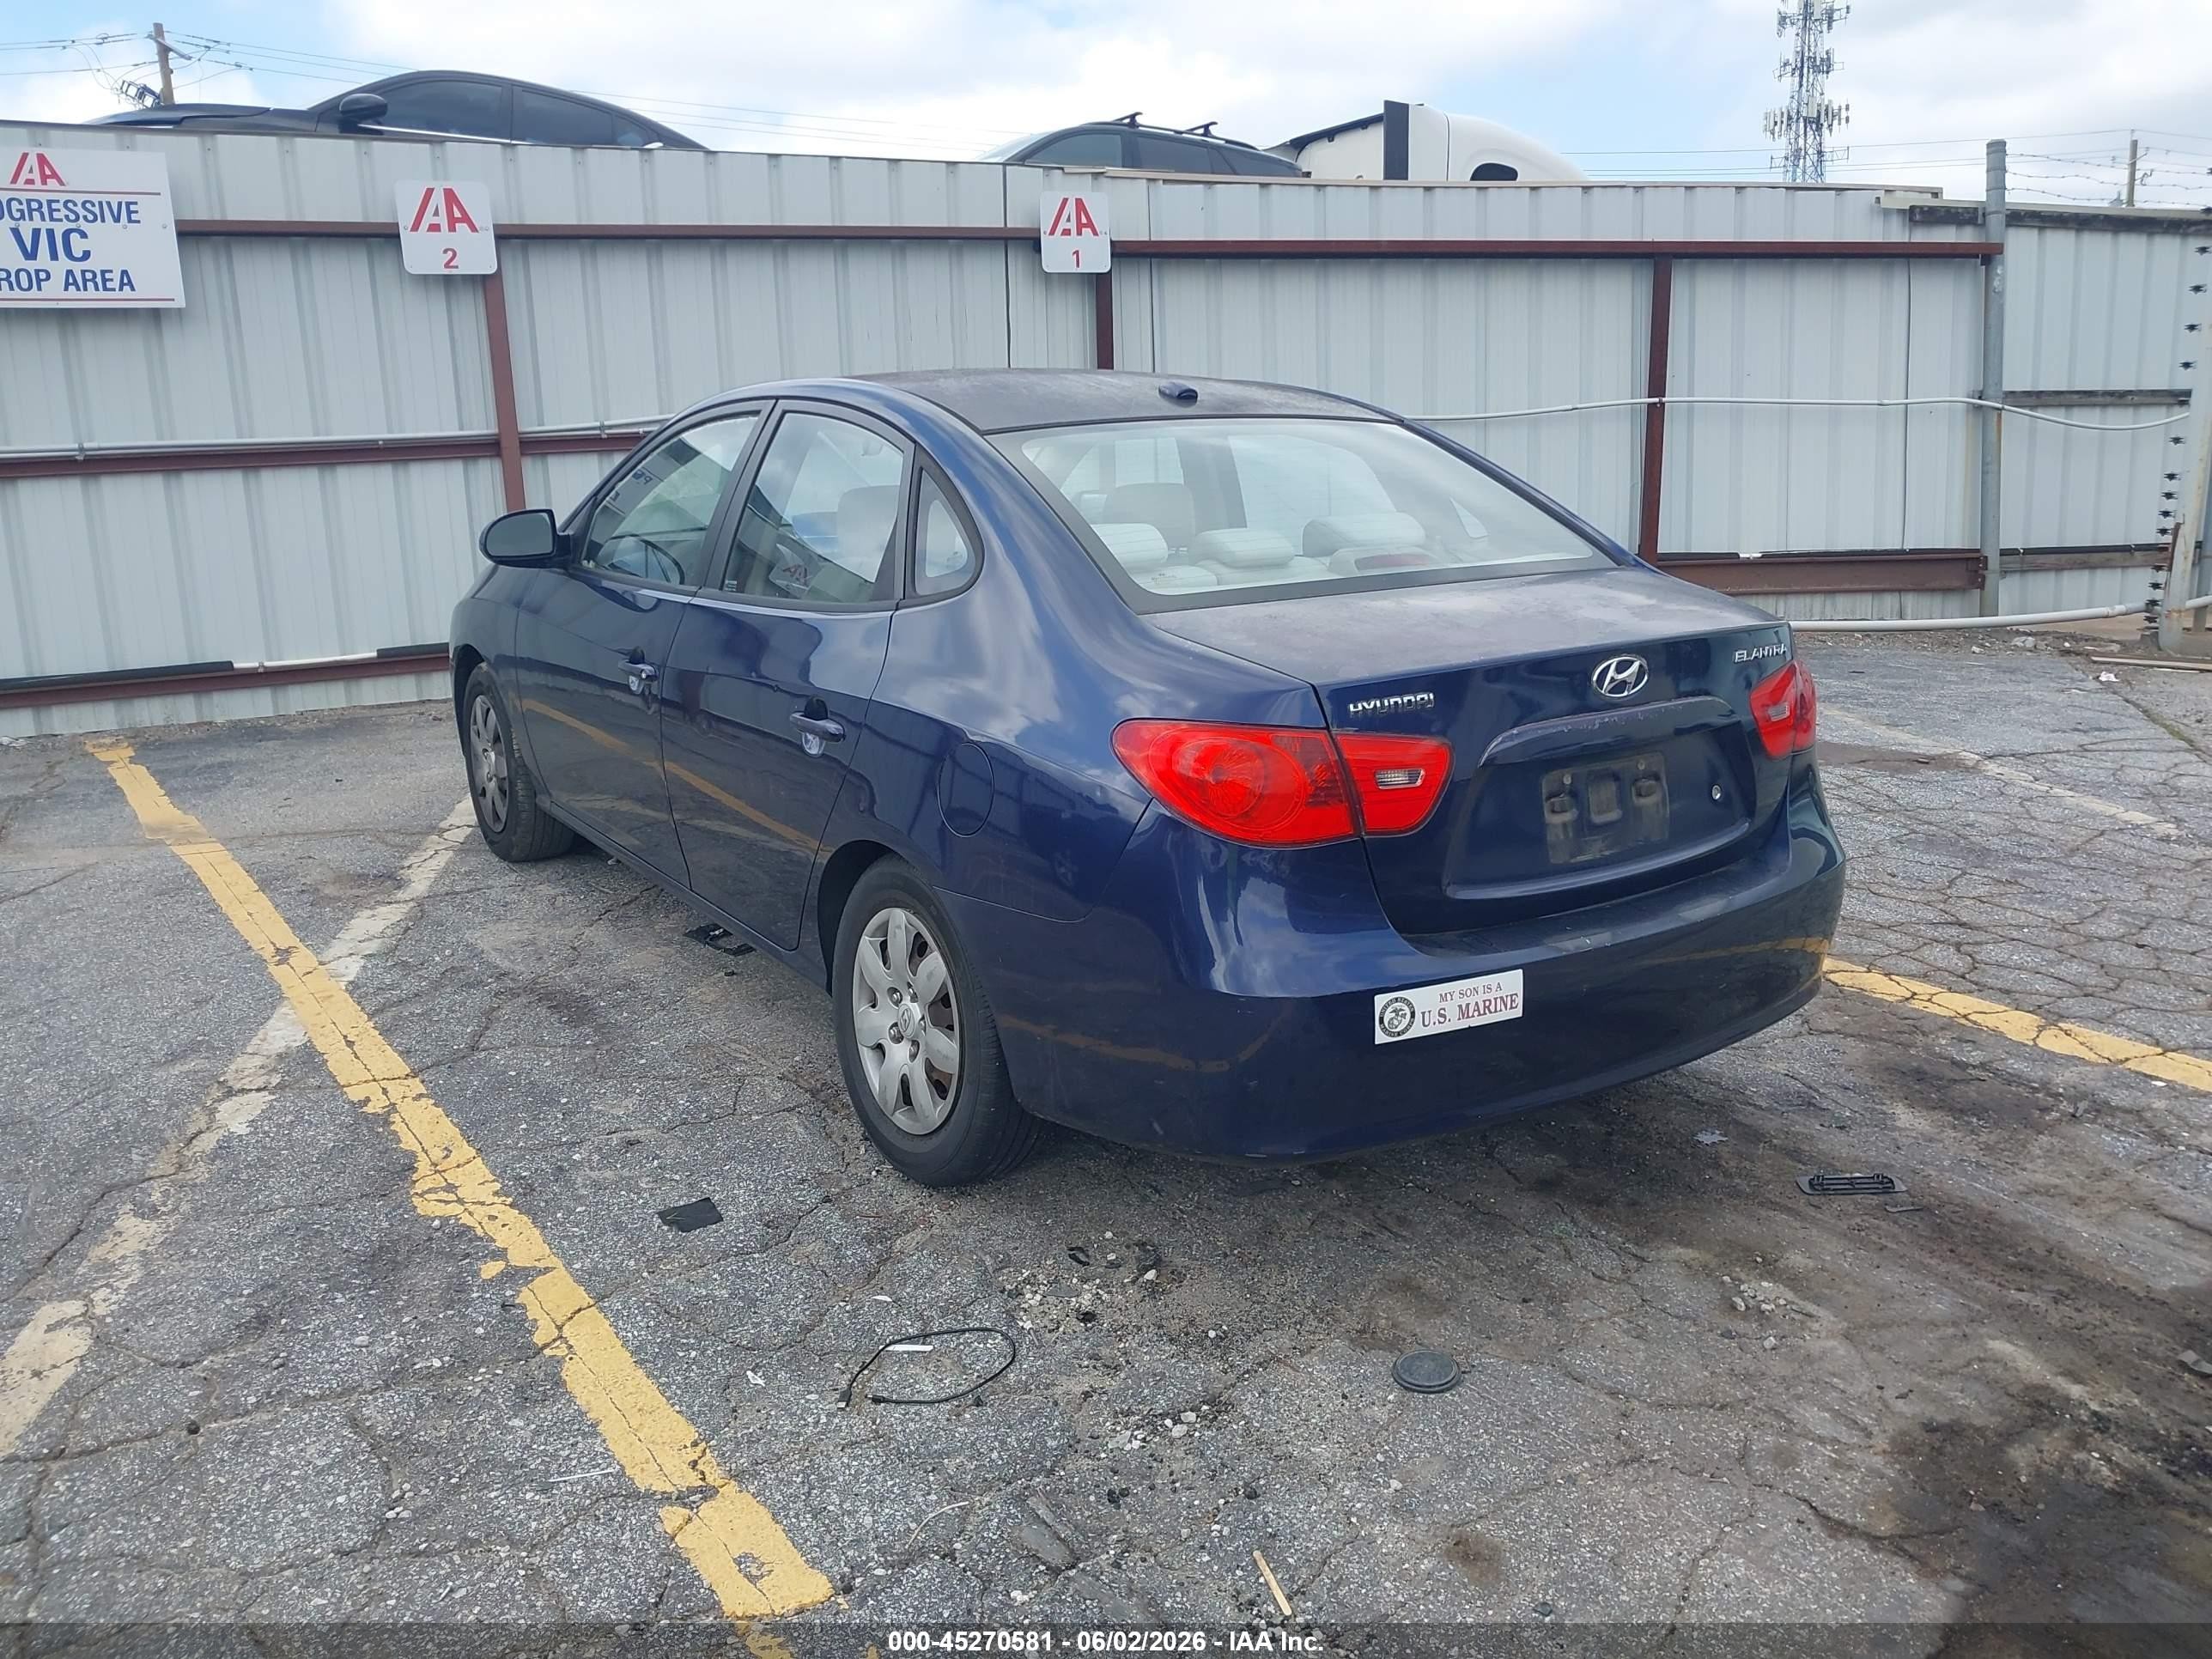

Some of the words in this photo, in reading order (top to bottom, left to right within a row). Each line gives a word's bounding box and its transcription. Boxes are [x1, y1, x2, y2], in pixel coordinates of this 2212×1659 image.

[0, 197, 141, 224] GRESSIVE
[9, 227, 91, 263] VIC
[442, 247, 459, 270] 2
[1072, 249, 1080, 269] 1
[63, 269, 137, 292] AREA
[1735, 643, 1788, 663] ELANTRA
[1349, 693, 1435, 718] HYUNDAI
[1439, 991, 1455, 1003] MY
[1458, 987, 1480, 1000] SON
[1482, 983, 1492, 994] IS
[1495, 981, 1503, 992] A
[1420, 1007, 1451, 1028] U.S.
[1456, 993, 1519, 1022] MARINE
